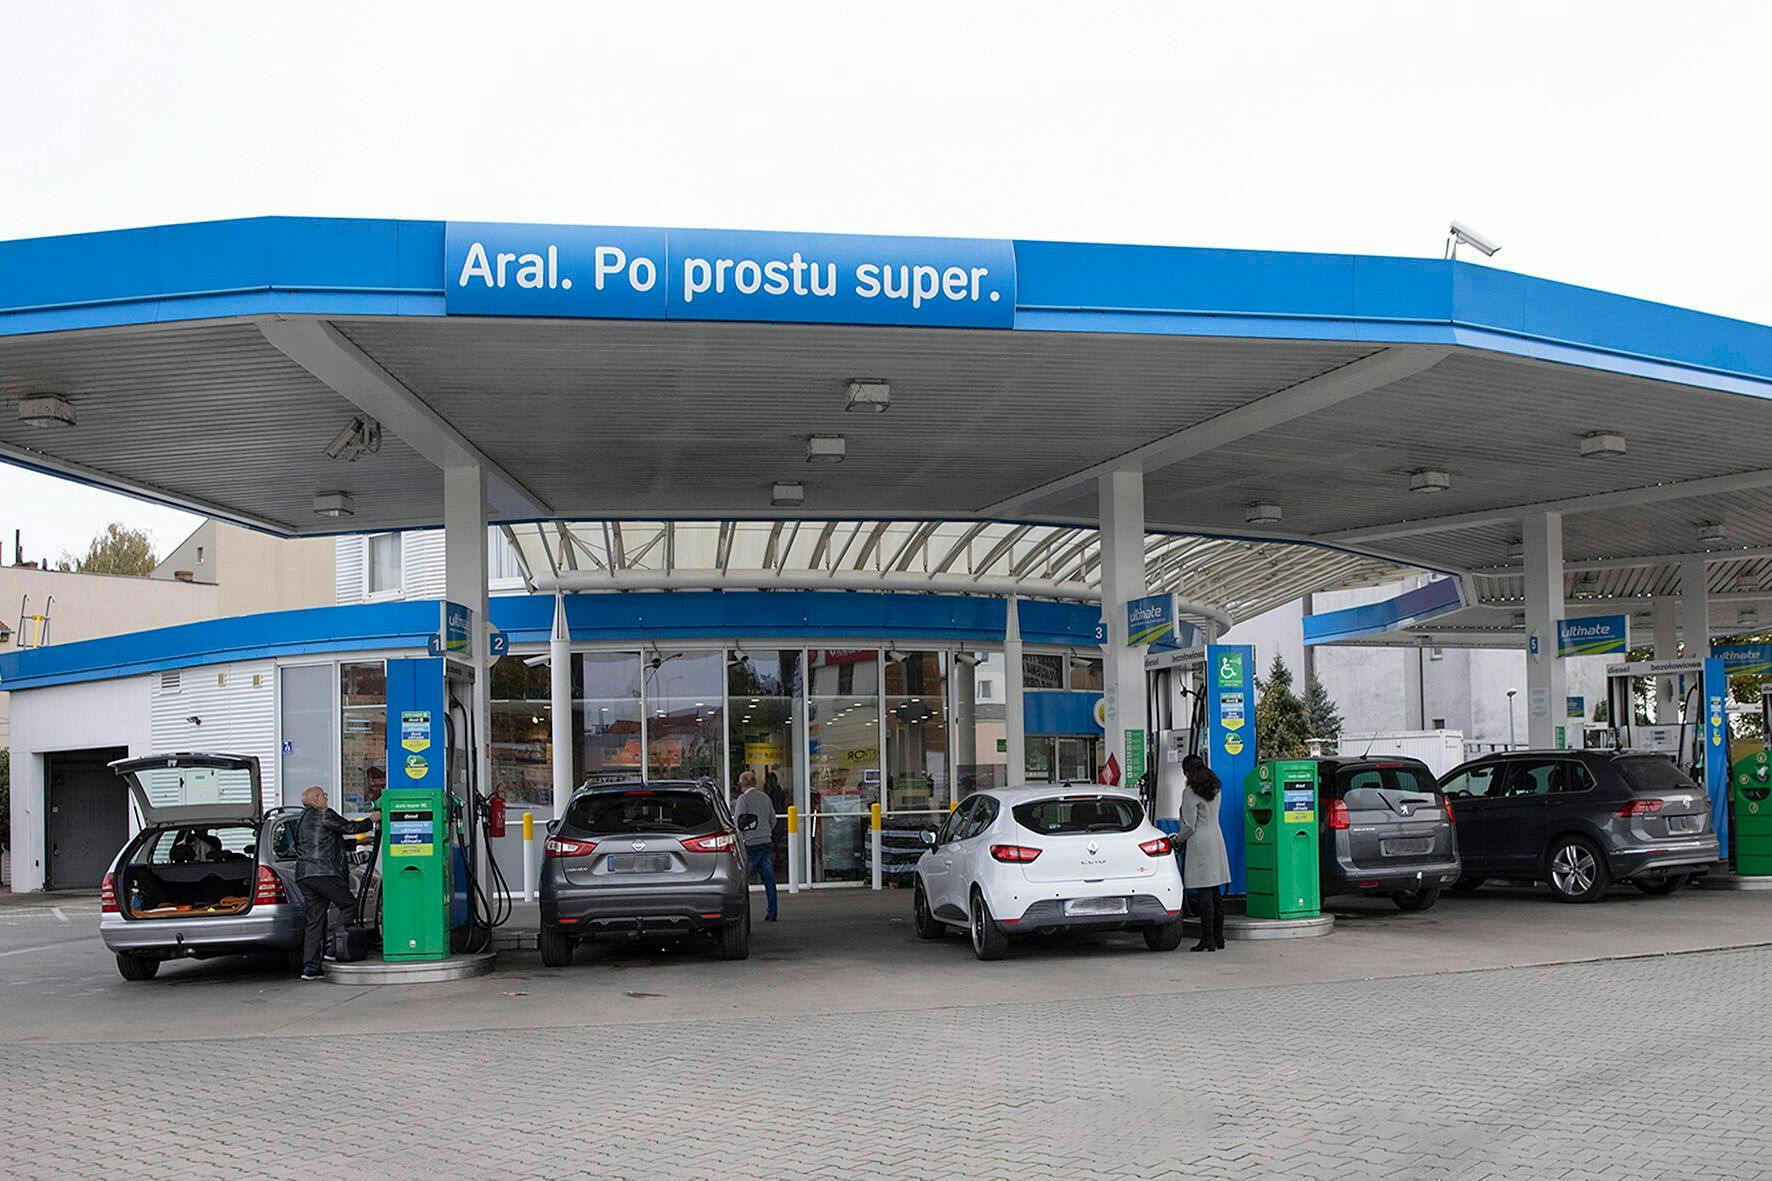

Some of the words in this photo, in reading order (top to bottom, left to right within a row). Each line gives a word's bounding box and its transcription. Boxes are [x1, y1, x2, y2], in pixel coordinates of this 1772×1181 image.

[459, 242, 572, 290] Aral.
[595, 245, 656, 292] Po
[684, 252, 837, 302] prostu
[855, 264, 1001, 308] super.
[1130, 605, 1161, 622] ultimate
[1095, 626, 1104, 640] 3
[1562, 624, 1611, 638] ultimate
[433, 638, 440, 651] 1
[494, 637, 504, 650] 2
[1531, 639, 1537, 650] 5
[1607, 666, 1630, 675] diesel
